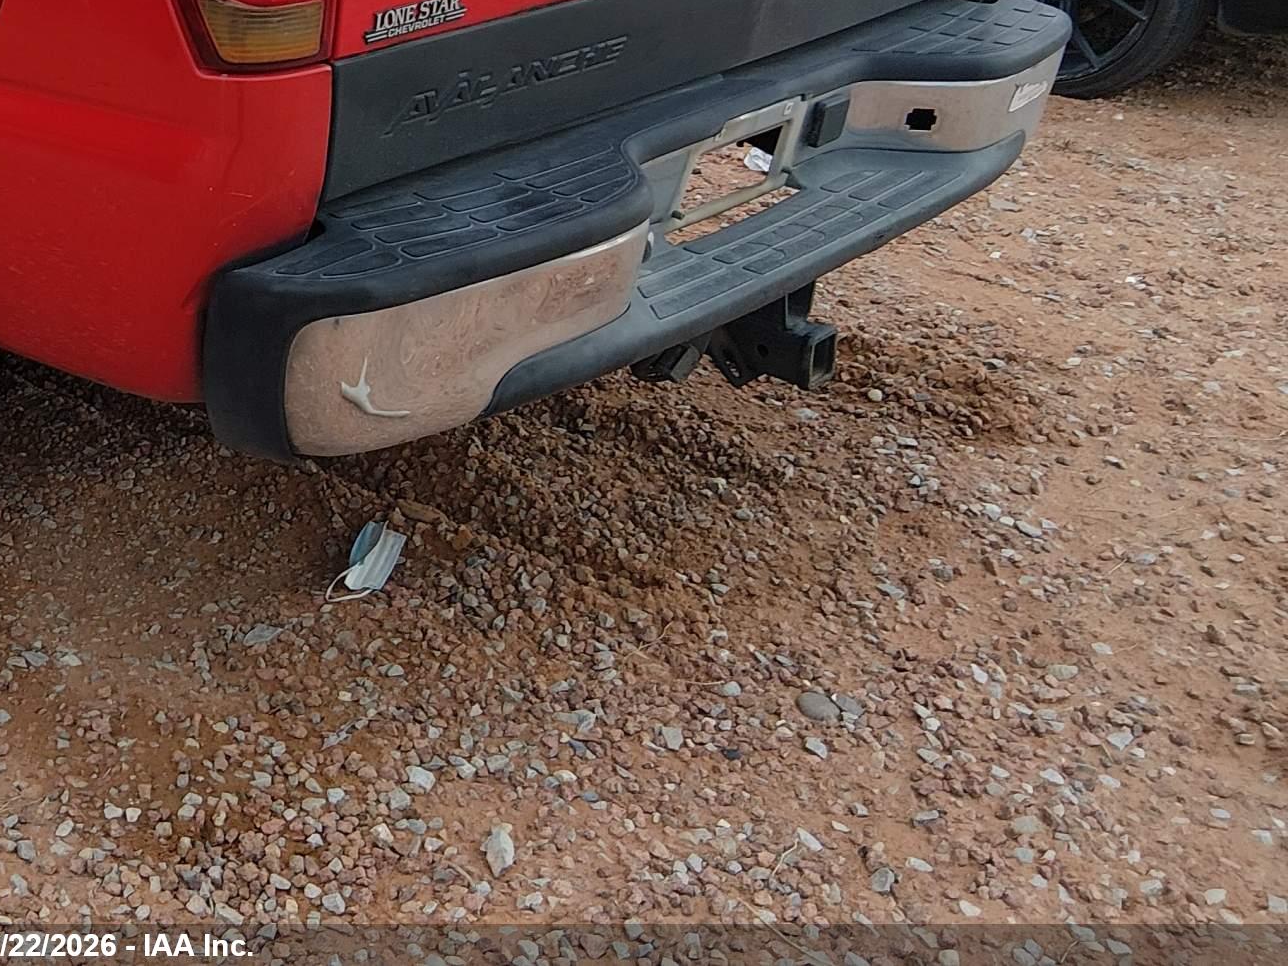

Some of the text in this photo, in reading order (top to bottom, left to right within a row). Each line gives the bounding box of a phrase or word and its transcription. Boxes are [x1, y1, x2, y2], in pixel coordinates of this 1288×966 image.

[375, 3, 418, 32] LONE
[387, 14, 446, 38] CHEVROLET
[383, 34, 627, 137] AVALANCHE
